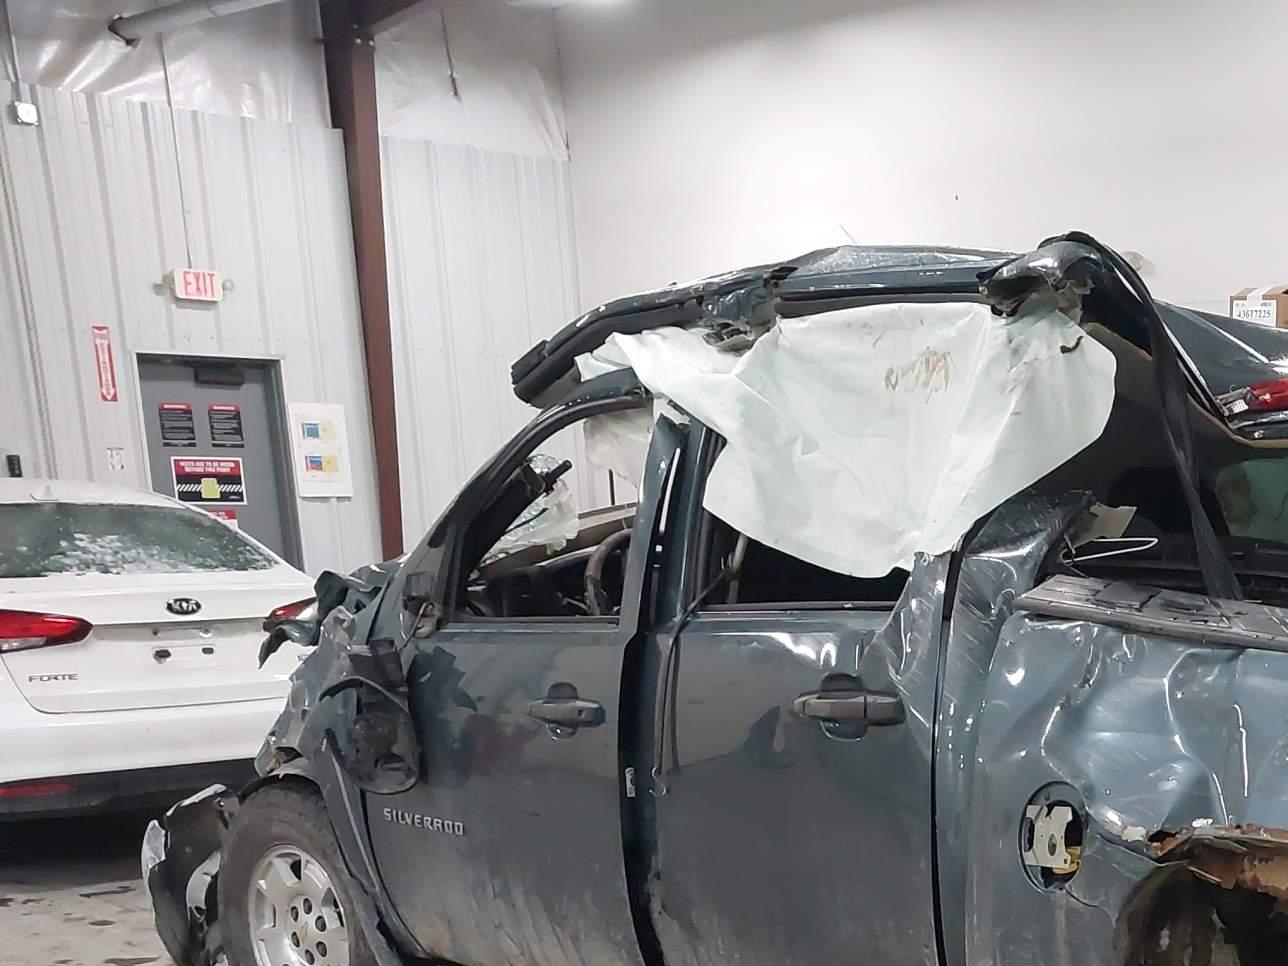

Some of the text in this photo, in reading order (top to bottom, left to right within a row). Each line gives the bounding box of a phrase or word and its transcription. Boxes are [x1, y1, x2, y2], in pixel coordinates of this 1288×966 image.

[183, 271, 216, 298] EXIT
[28, 673, 79, 684] FORTE
[383, 807, 464, 836] SILVERADO
